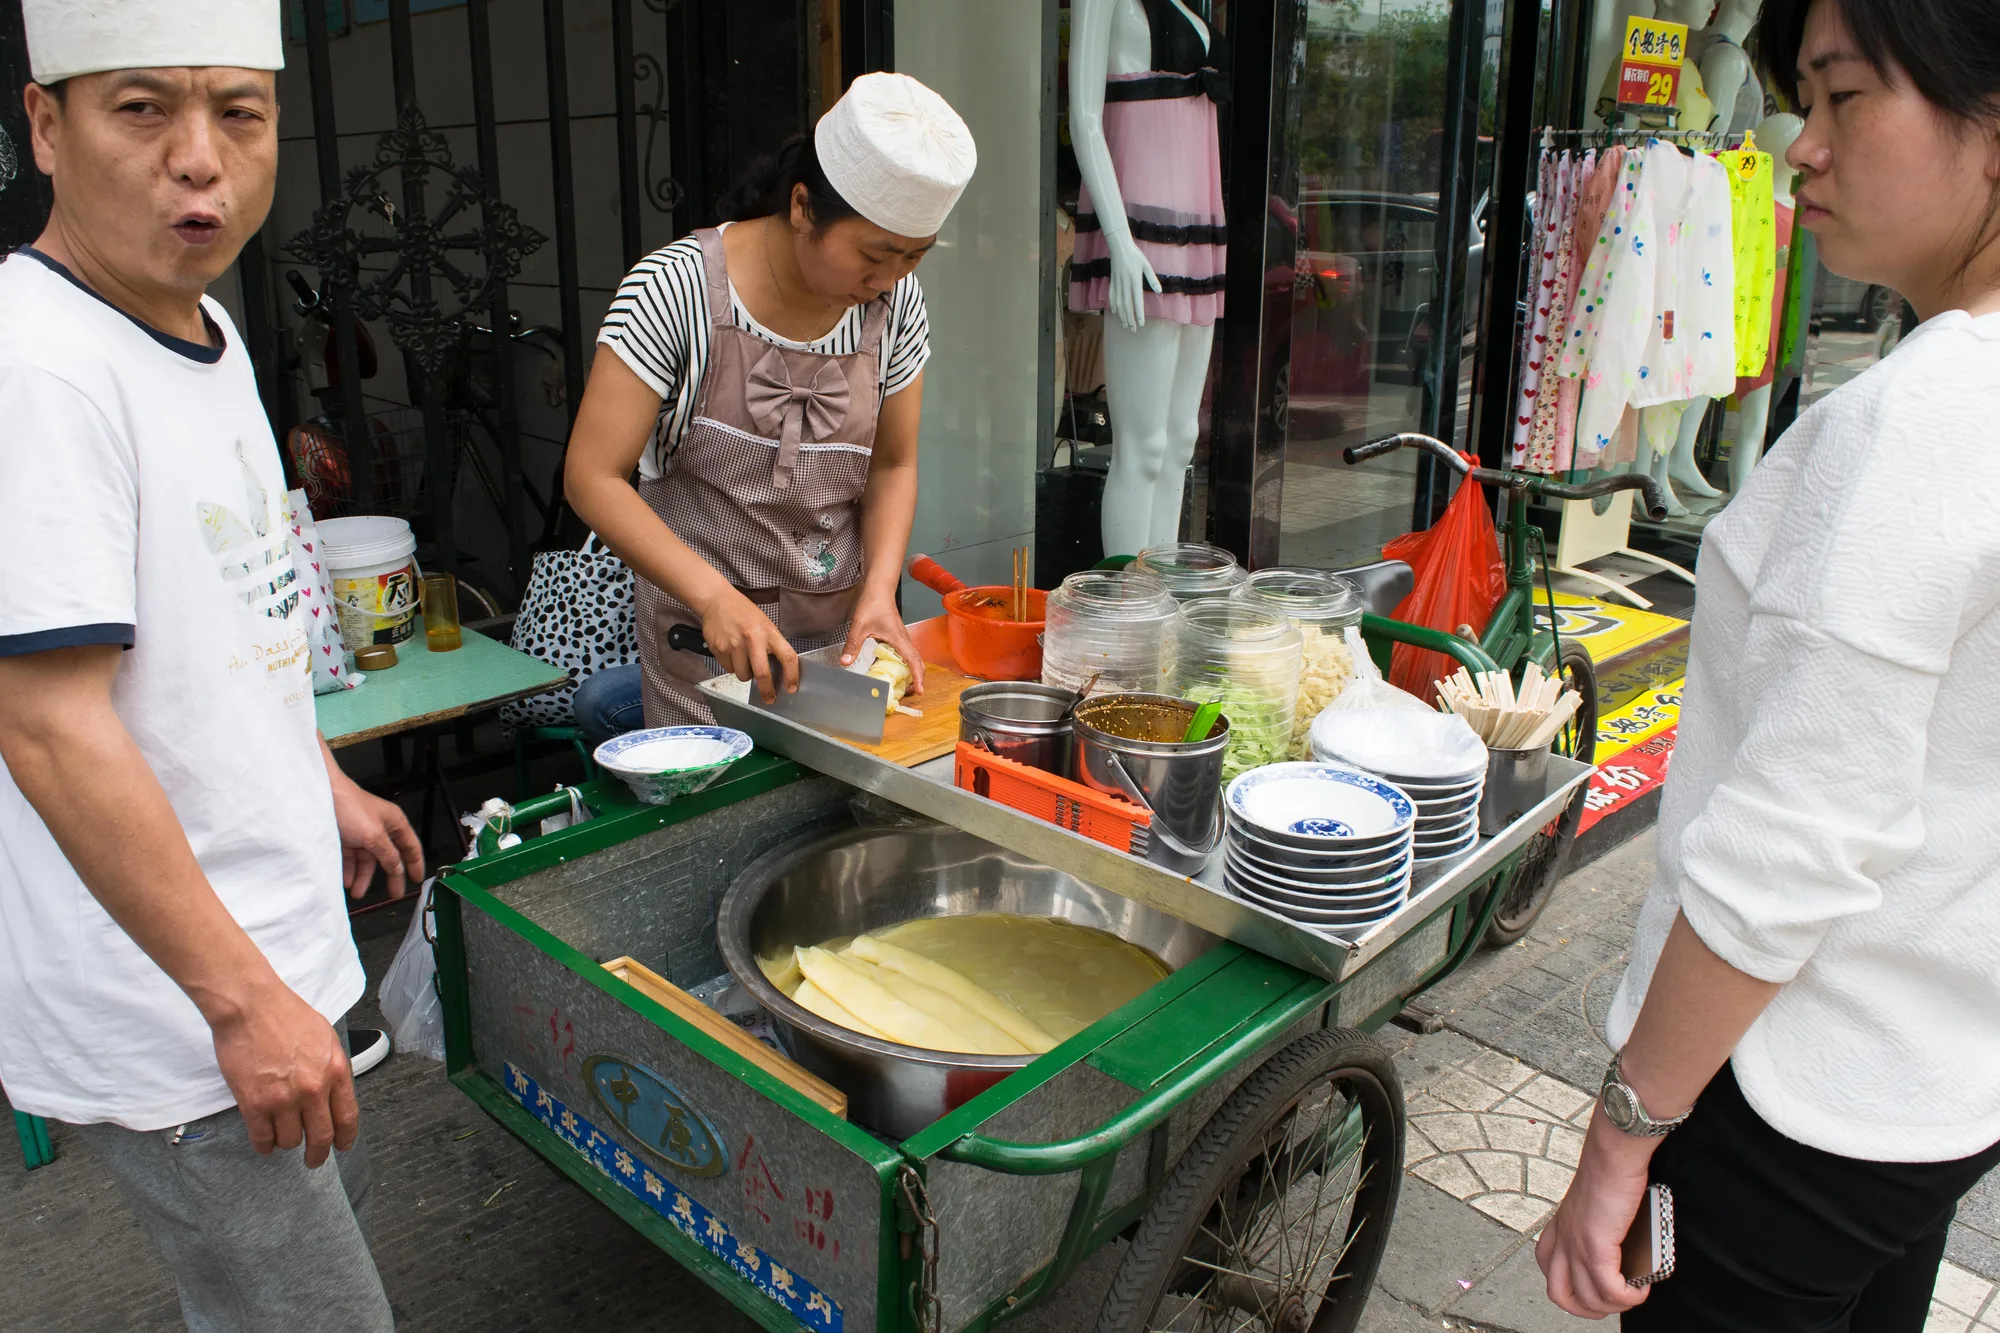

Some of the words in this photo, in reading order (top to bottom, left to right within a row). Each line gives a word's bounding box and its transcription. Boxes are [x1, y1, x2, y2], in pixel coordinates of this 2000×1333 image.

[1629, 27, 1681, 60] 全部清仓
[1645, 72, 1673, 106] 29
[610, 1067, 700, 1165] 中原
